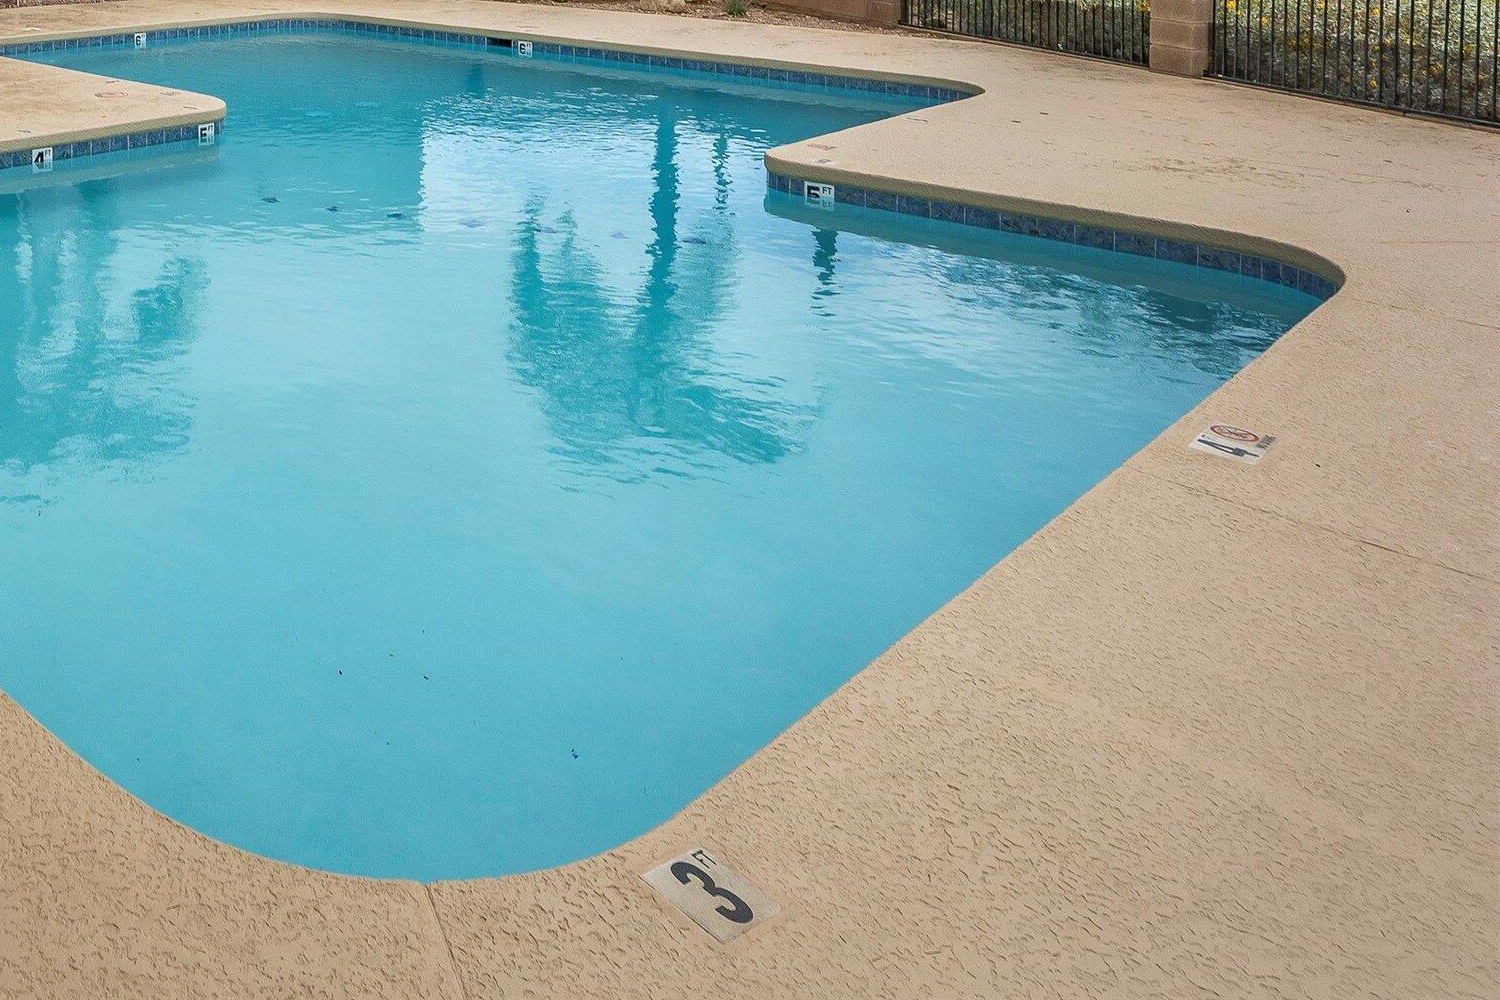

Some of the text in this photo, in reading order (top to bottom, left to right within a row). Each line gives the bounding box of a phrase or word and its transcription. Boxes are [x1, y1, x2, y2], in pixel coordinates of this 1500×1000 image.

[34, 151, 44, 162] 4
[807, 185, 820, 198] 5
[1197, 438, 1259, 457] 4
[670, 849, 754, 924] 3 FT
